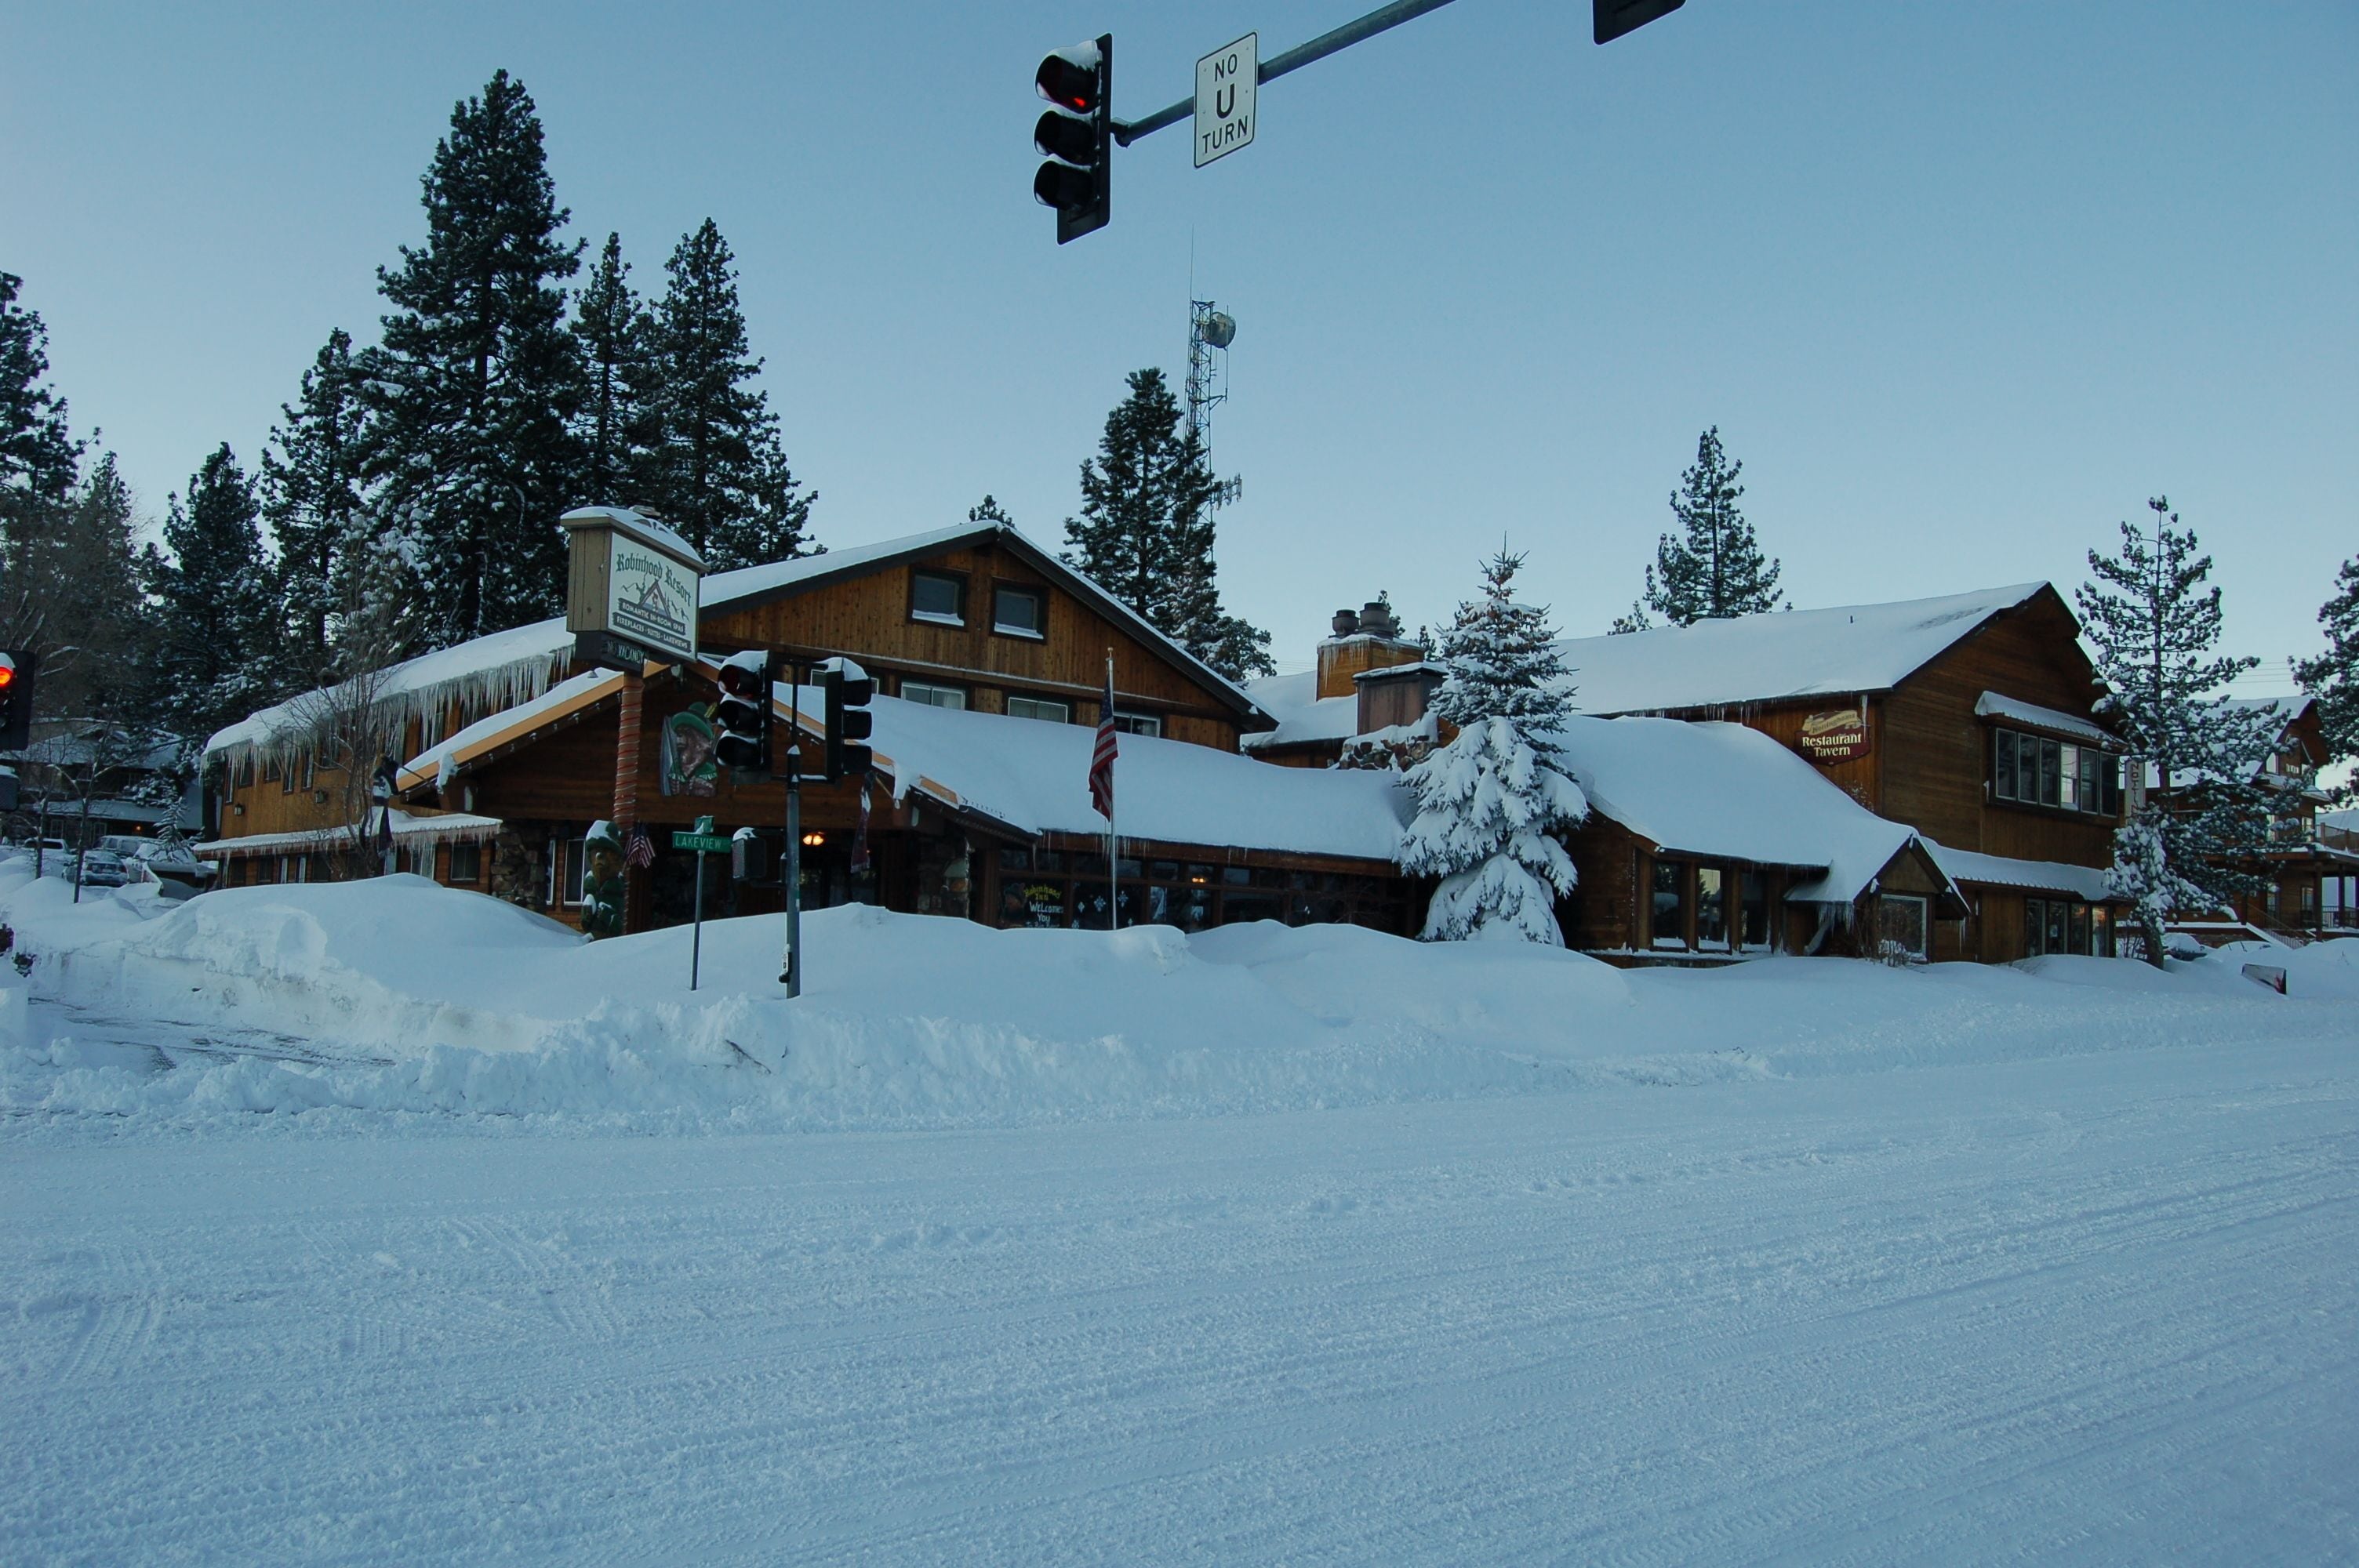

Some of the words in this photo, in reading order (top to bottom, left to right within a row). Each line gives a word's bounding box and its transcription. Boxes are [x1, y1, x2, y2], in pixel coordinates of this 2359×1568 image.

[1215, 53, 1238, 82] NO
[1216, 82, 1234, 119] U
[1202, 115, 1248, 154] TURN
[615, 553, 663, 579] Robinhood
[664, 565, 691, 607] Resort
[622, 602, 649, 619] ROMANTIC
[617, 615, 645, 633] FIREPLACES
[663, 630, 688, 649] LAKEVIEWS
[618, 644, 645, 664] VACANCY
[1802, 733, 1862, 746] Restaurant
[1814, 746, 1851, 757] Tavern
[675, 835, 722, 849] LAKEVIEW
